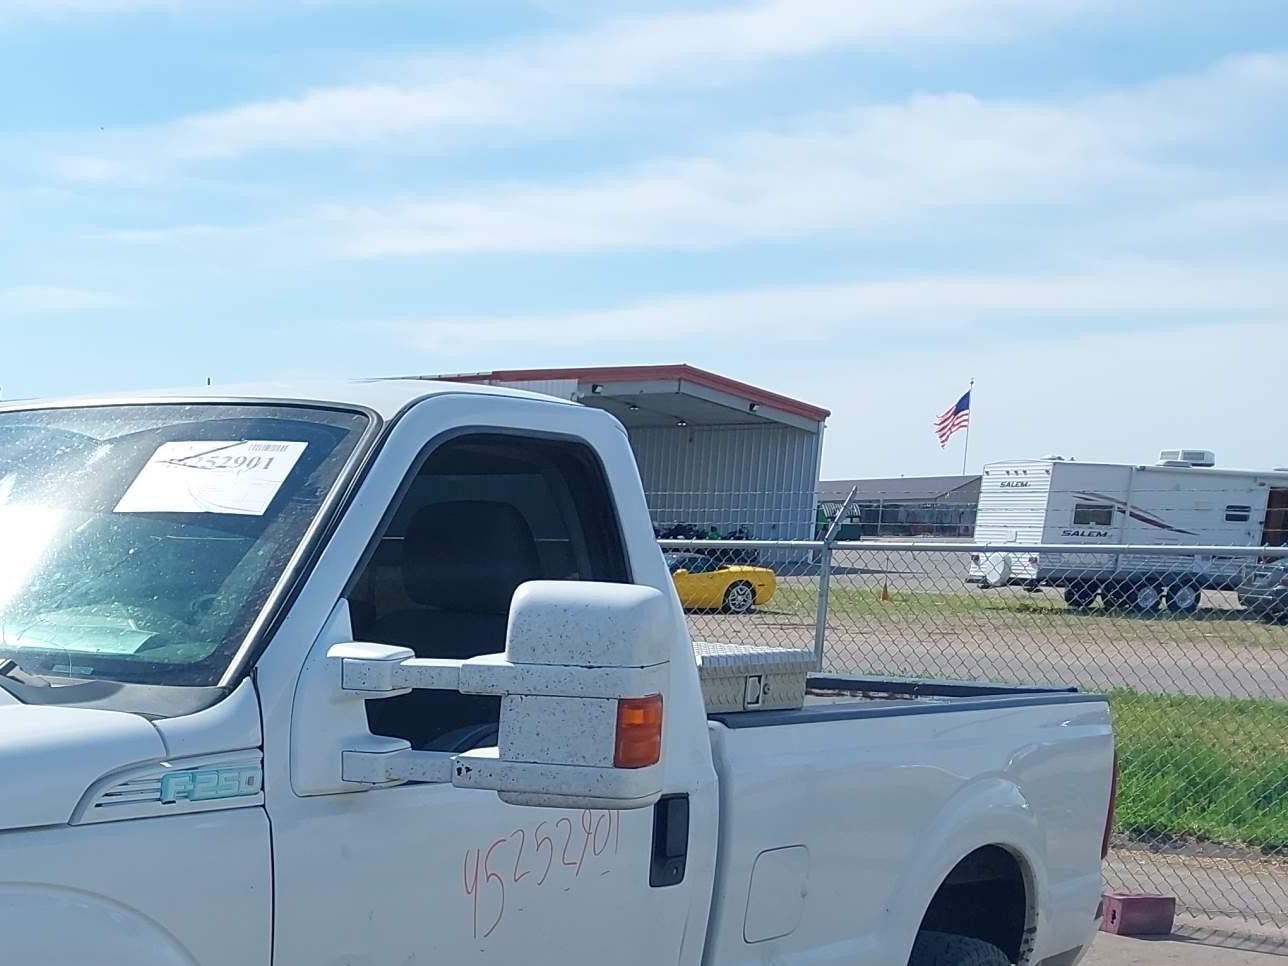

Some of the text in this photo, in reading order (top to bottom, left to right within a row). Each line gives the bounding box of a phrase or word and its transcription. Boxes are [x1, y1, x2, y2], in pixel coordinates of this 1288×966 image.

[999, 480, 1028, 488] SALEM
[1060, 529, 1108, 538] SALEM
[464, 807, 620, 939] 45252901
